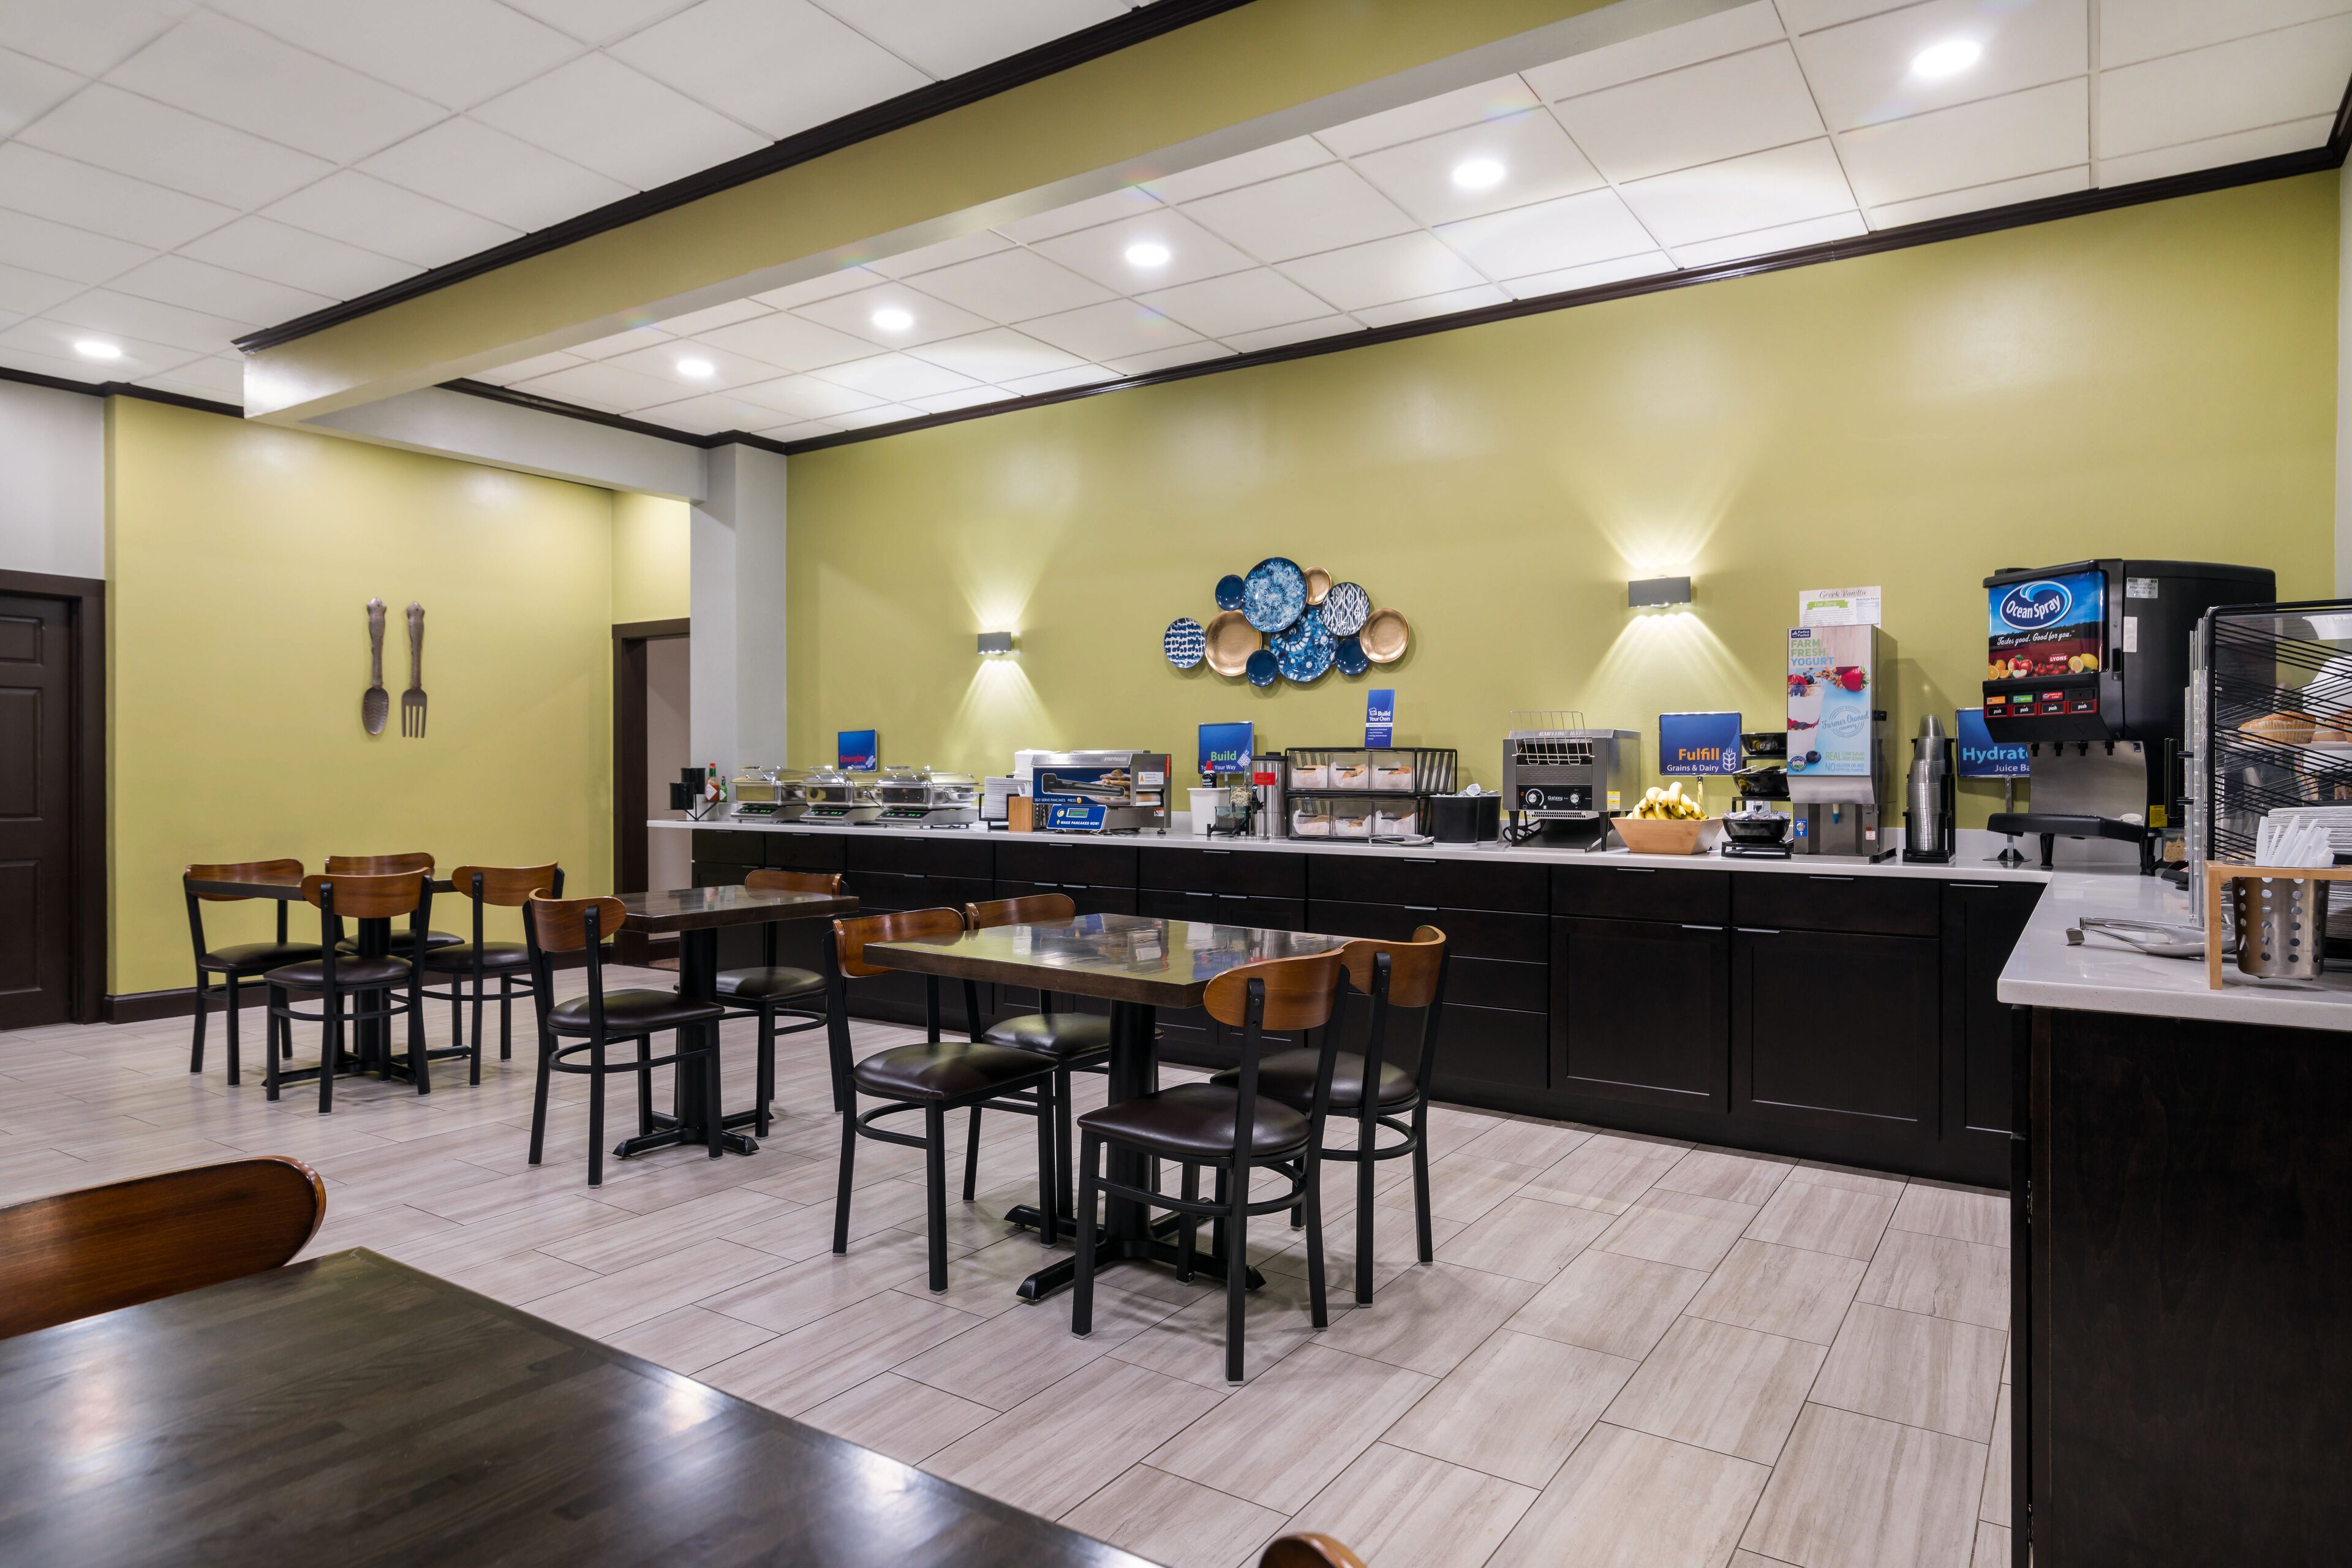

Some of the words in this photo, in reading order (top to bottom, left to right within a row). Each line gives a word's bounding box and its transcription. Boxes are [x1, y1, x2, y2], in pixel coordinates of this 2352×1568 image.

[2006, 600, 2033, 619] Ocean
[2034, 595, 2060, 620] Spray
[1791, 639, 1820, 647] FARM
[1997, 636, 2014, 646] Tastes
[2015, 635, 2030, 647] good.
[2033, 631, 2049, 641] Good
[2049, 631, 2058, 641] for
[2058, 632, 2071, 641] you.
[1791, 648, 1826, 657] FRESH
[1791, 657, 1834, 666] YOGURT
[1822, 719, 1845, 729] Farmer
[1847, 710, 1869, 723] Owned
[1211, 750, 1237, 761] Build
[1679, 747, 1719, 760] Fulfill
[1825, 751, 1841, 761] REAL
[1962, 746, 2029, 764] Hydrat
[840, 755, 867, 764] Energize
[1825, 763, 1836, 772] NO
